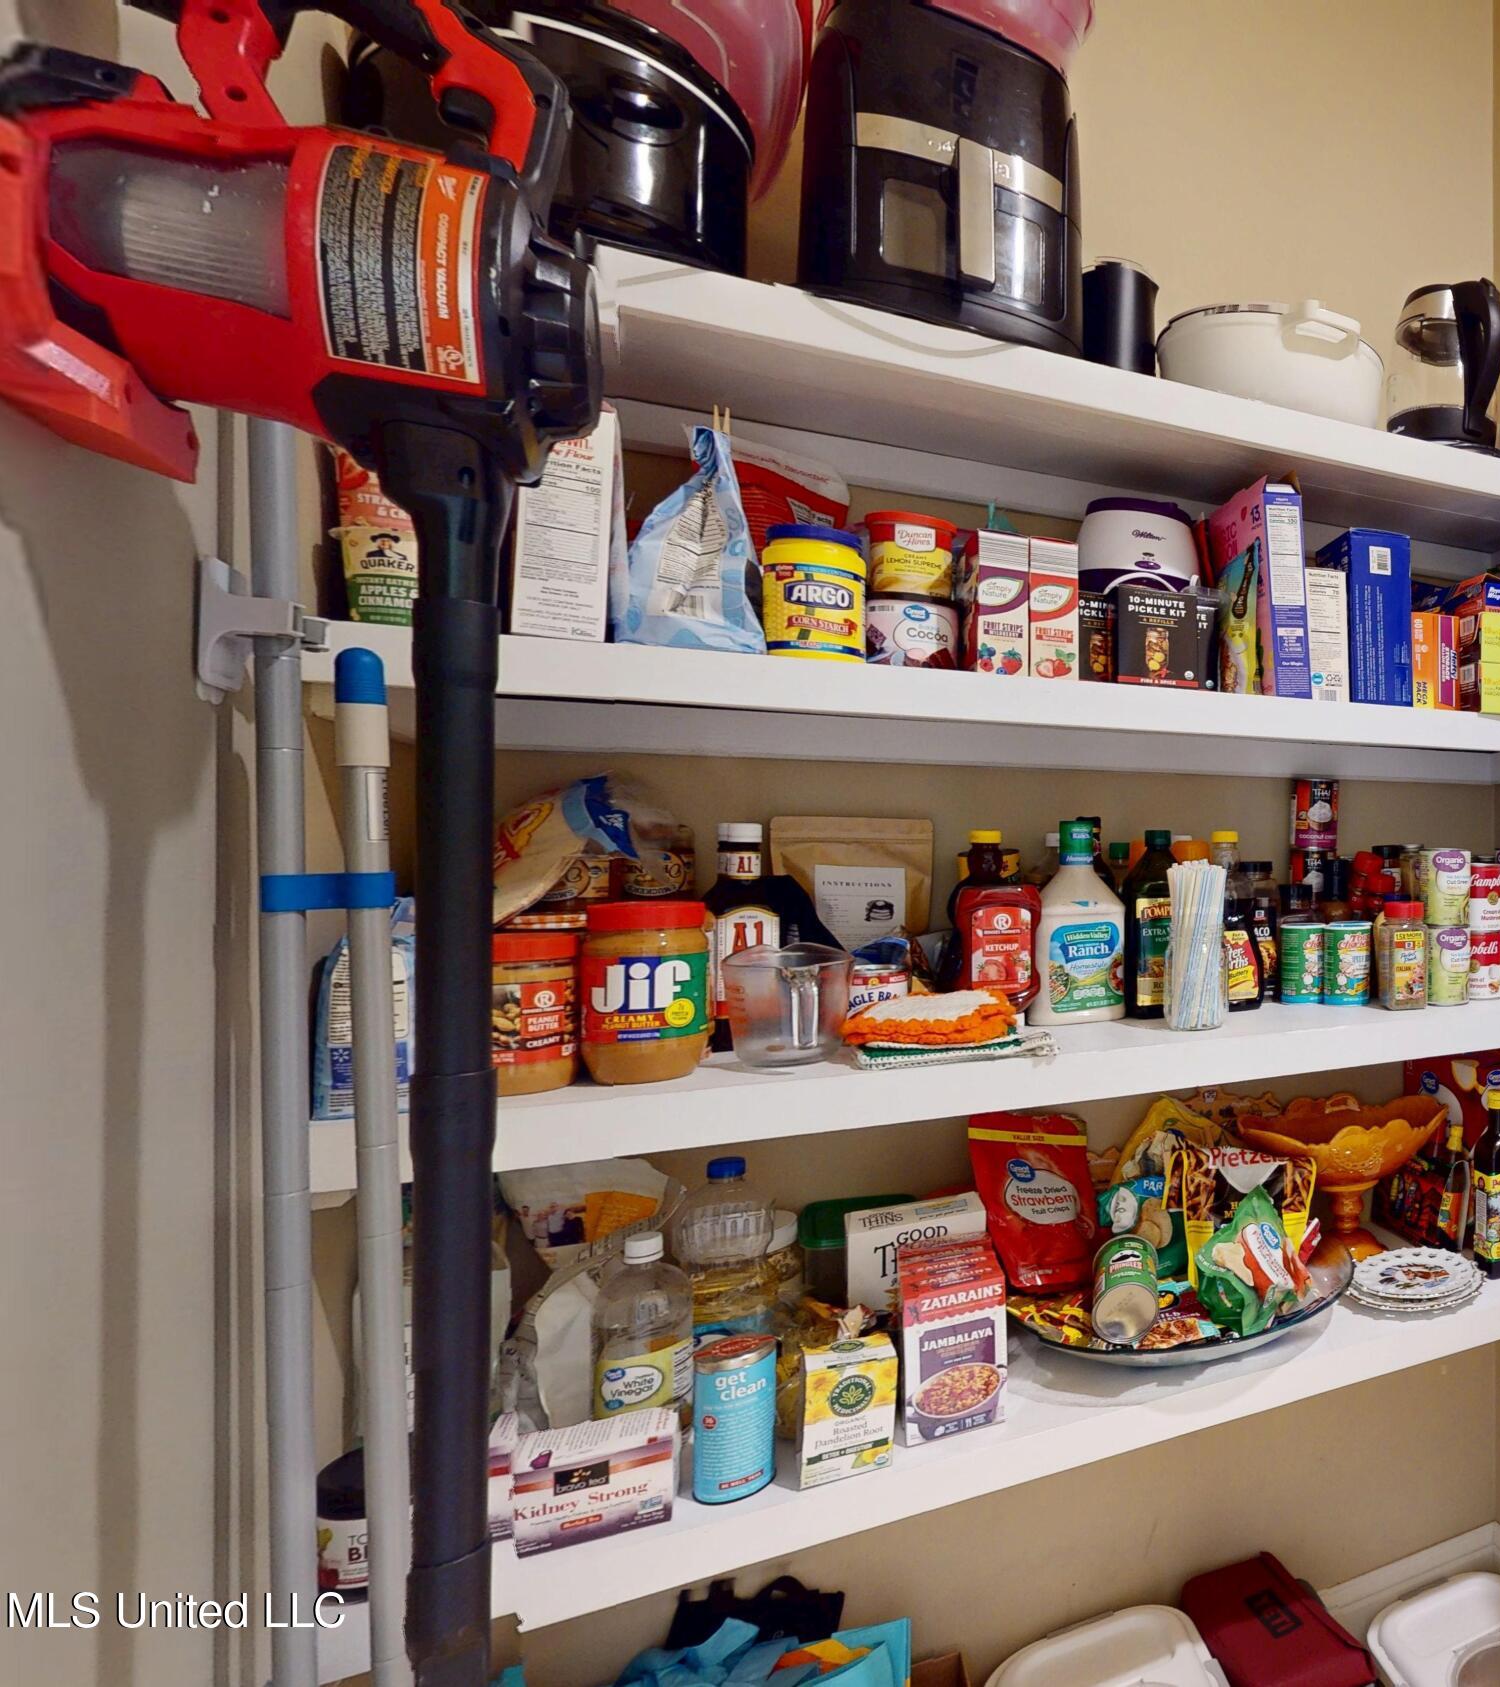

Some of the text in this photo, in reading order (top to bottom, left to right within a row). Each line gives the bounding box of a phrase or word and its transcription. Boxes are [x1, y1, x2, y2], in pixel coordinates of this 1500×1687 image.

[436, 212, 450, 320] COMPACT VACUUM
[564, 449, 592, 461] Flour
[898, 529, 932, 539] Duncan
[1131, 529, 1166, 541] Wilton
[360, 559, 415, 572] QUAKER
[913, 558, 943, 570] SUPREME
[360, 585, 419, 599] APPLES &
[982, 590, 1007, 599] Nature
[987, 584, 1012, 594] Simply
[791, 585, 850, 608] ARGO
[1129, 595, 1185, 608] 10-MINUTE
[1128, 604, 1187, 617] PICKLE KIT
[792, 615, 849, 633] CORN STARCH
[984, 620, 1023, 633] FRUIT STRIPS
[906, 627, 949, 643] Cocoa
[1035, 627, 1074, 639] FRUIT STRIPS
[1450, 650, 1458, 680] Hefty
[1435, 856, 1464, 865] Organic
[822, 880, 893, 888] INSTRUCTIONS
[1066, 930, 1109, 943] Hidden Valley
[1142, 928, 1166, 937] EXTRA
[1439, 934, 1466, 943] Organic
[985, 943, 1019, 952] KETCHUP
[1068, 943, 1109, 958] Ranch
[591, 960, 691, 1013] Jif
[848, 991, 875, 1011] AGLE
[527, 1014, 560, 1025] PEANUT
[601, 1020, 661, 1031] PEANUT BUTTER
[605, 1014, 655, 1024] CREAMY
[528, 1022, 560, 1032] BUTTER
[526, 1036, 561, 1049] CREAMY
[1016, 1186, 1068, 1194] Freeze Dried
[1047, 1206, 1070, 1214] Crisps
[859, 1213, 904, 1228] THINS
[897, 1225, 948, 1245] GOOD
[1109, 1260, 1143, 1273] PRINGLES
[921, 1284, 1002, 1312] ZATARAIN'S
[922, 1327, 994, 1352] JAMBALAYA
[622, 1378, 656, 1390] White
[715, 1372, 747, 1391] get
[833, 1377, 872, 1397] TRADITIONAL
[610, 1385, 655, 1399] Vinegar
[720, 1378, 767, 1401] clean
[833, 1421, 868, 1436] Roasted
[814, 1425, 884, 1450] Dandelion Root
[555, 1476, 606, 1494] bravo tea
[513, 1482, 649, 1522] Kidney Strong
